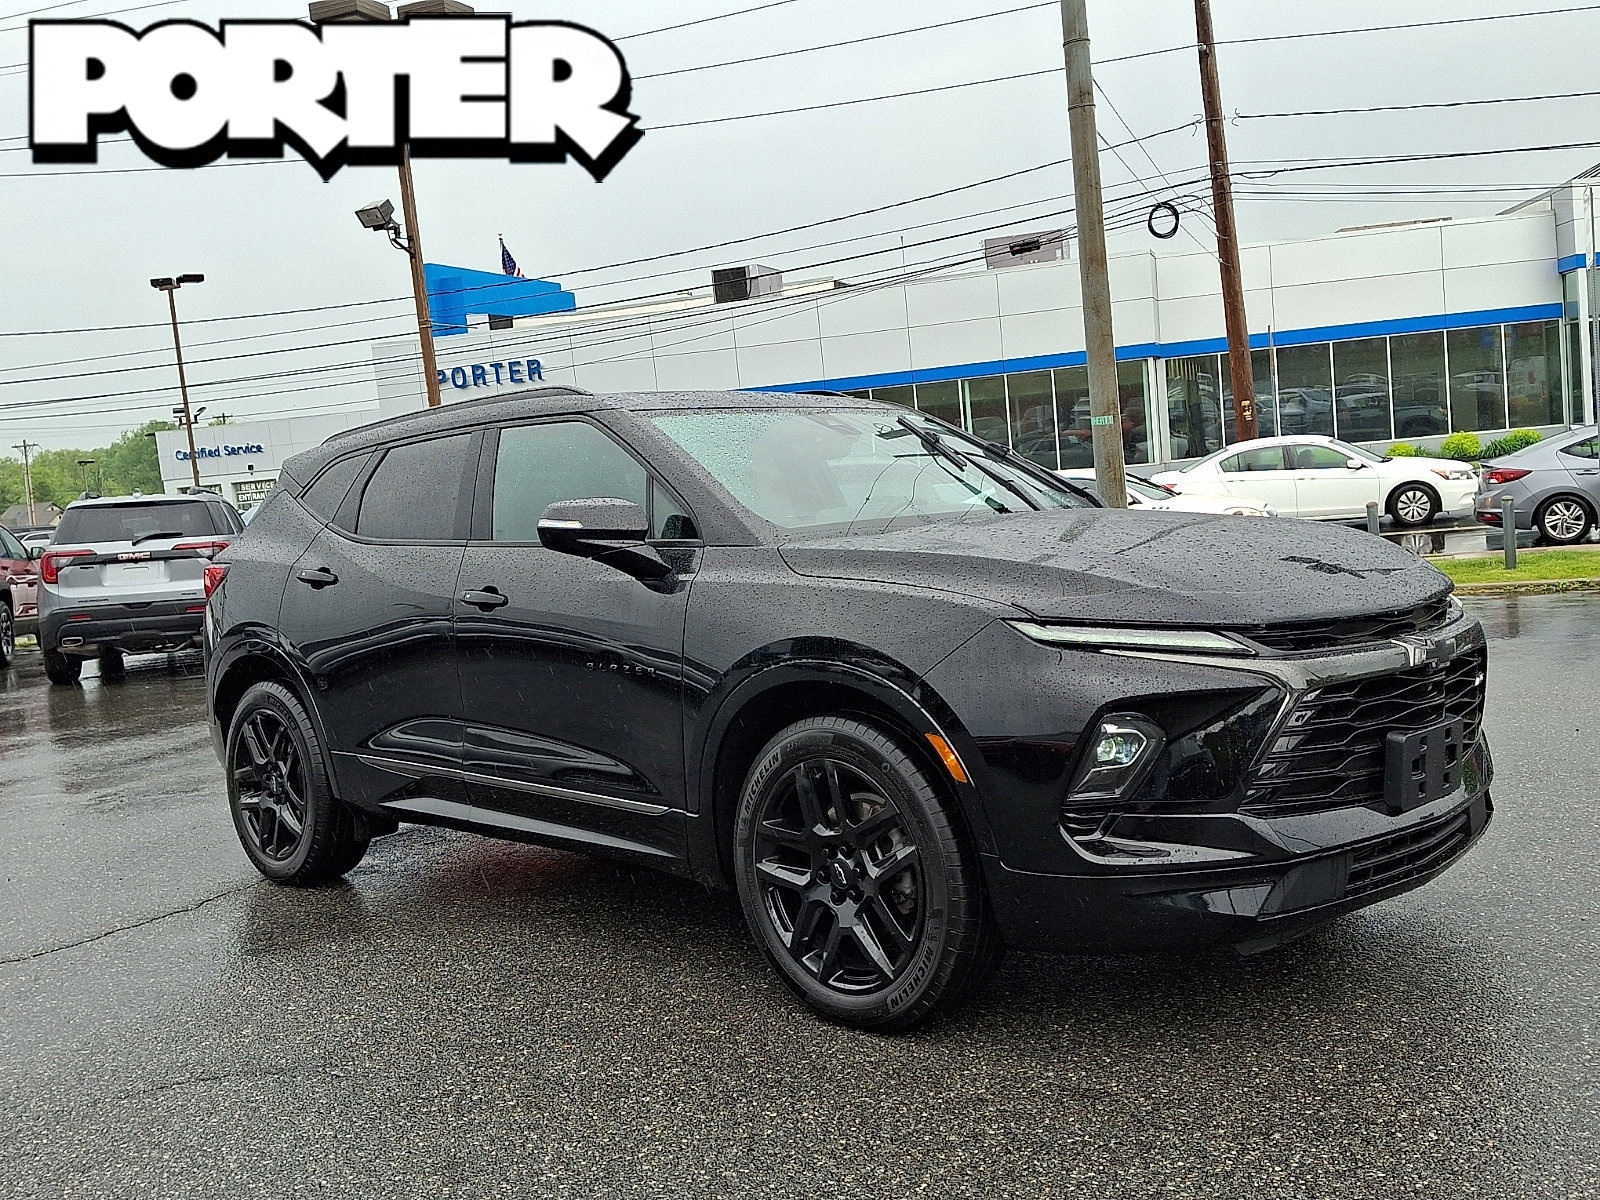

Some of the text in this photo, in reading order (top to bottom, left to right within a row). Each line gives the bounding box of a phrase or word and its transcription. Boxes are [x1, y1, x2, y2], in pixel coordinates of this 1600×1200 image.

[436, 359, 544, 389] PORTER
[223, 443, 263, 456] Service
[117, 552, 151, 560] GMC
[743, 751, 781, 815] MICHELIN
[889, 945, 935, 1010] MICHELIN
